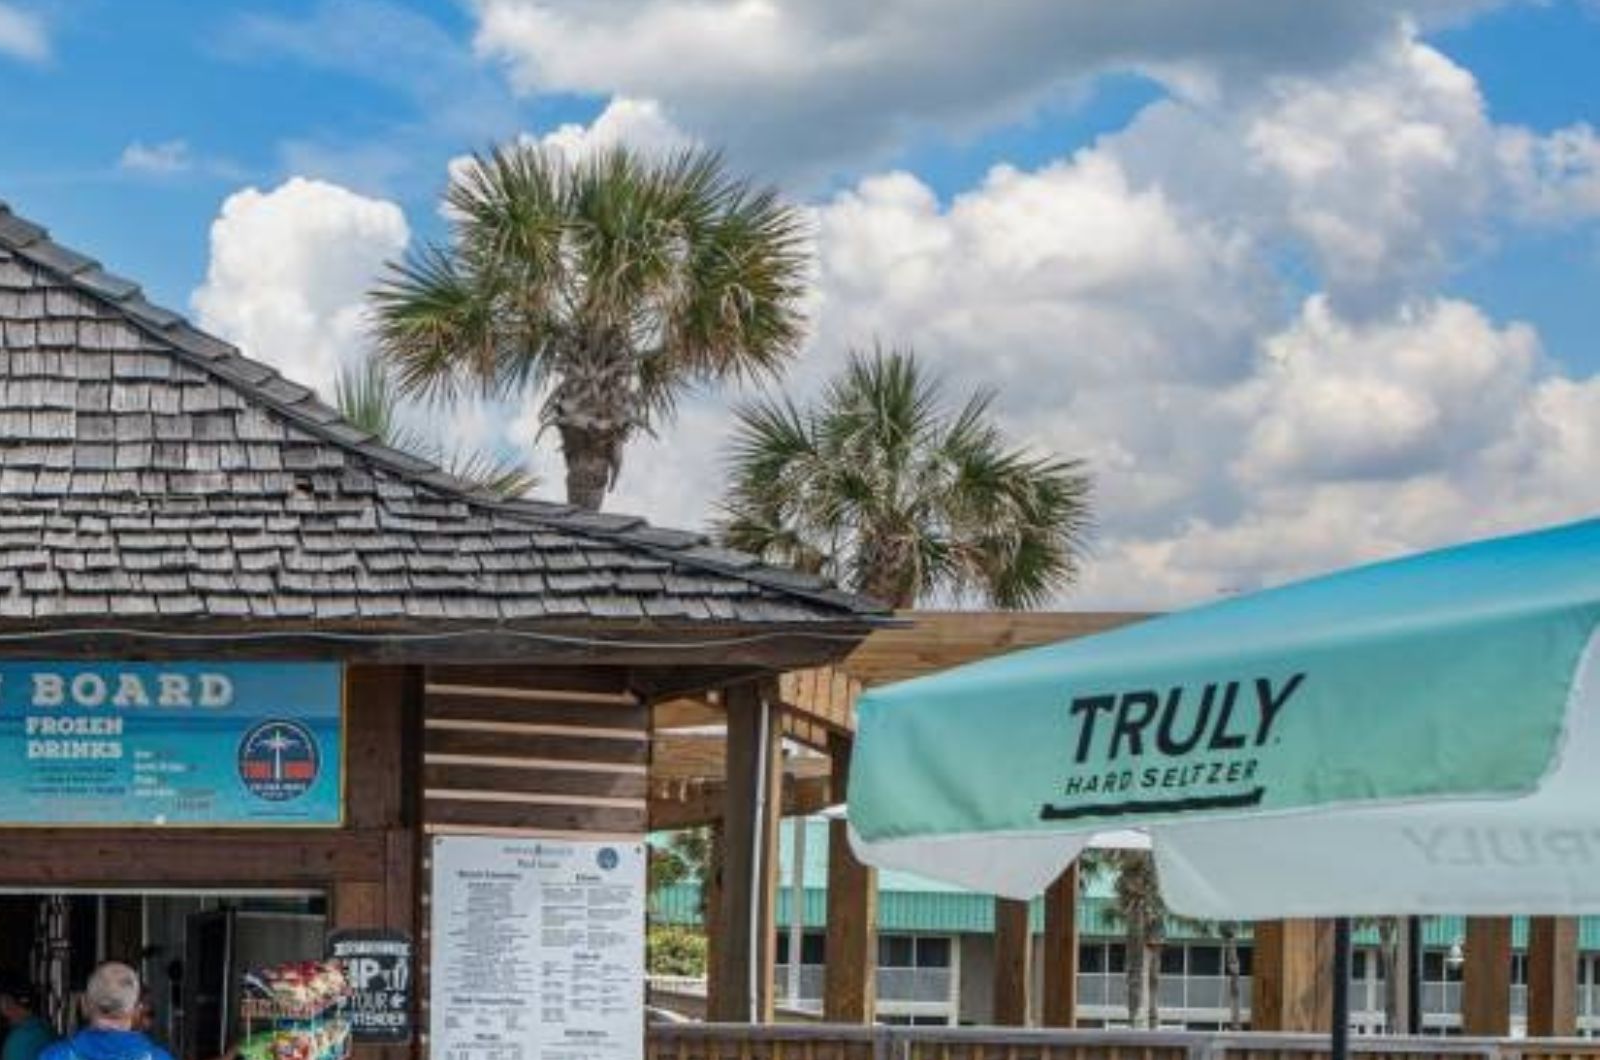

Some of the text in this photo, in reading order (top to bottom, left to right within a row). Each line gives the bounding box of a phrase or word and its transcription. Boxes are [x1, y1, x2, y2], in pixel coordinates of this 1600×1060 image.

[31, 673, 235, 707] BOARD
[25, 717, 123, 736] FROZEN
[1068, 671, 1306, 765] TRULY
[27, 741, 122, 759] DRINKS
[1065, 758, 1260, 796] HARD SELTZER
